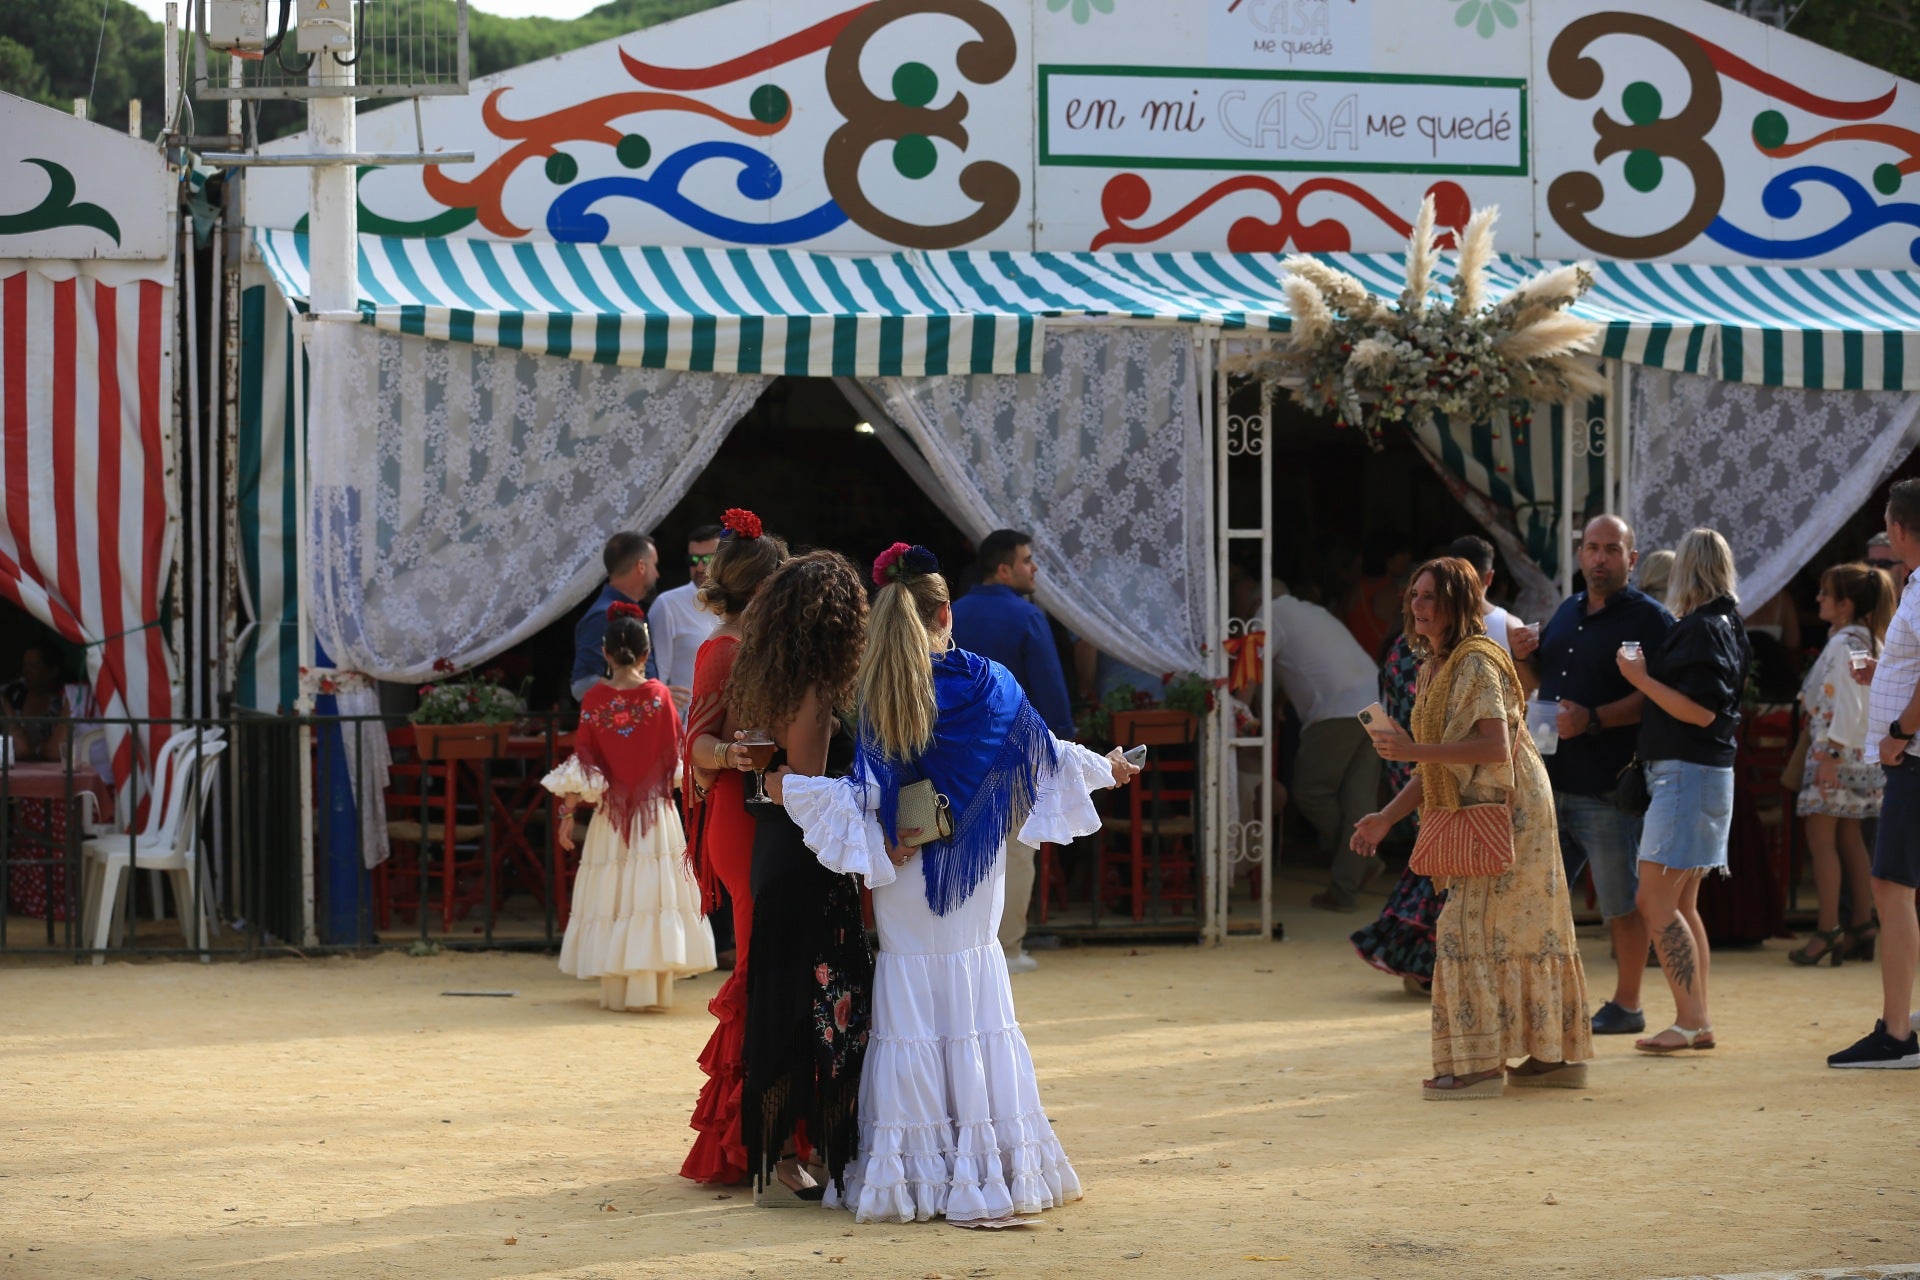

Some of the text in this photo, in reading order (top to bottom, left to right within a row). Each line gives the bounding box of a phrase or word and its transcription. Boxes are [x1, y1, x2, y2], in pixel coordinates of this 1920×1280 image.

[1247, 0, 1330, 36] CASA
[1281, 37, 1333, 63] quedé
[1066, 98, 1125, 130] en
[1141, 89, 1205, 132] mi
[1217, 89, 1359, 150] CASA
[1417, 107, 1511, 158] quedé
